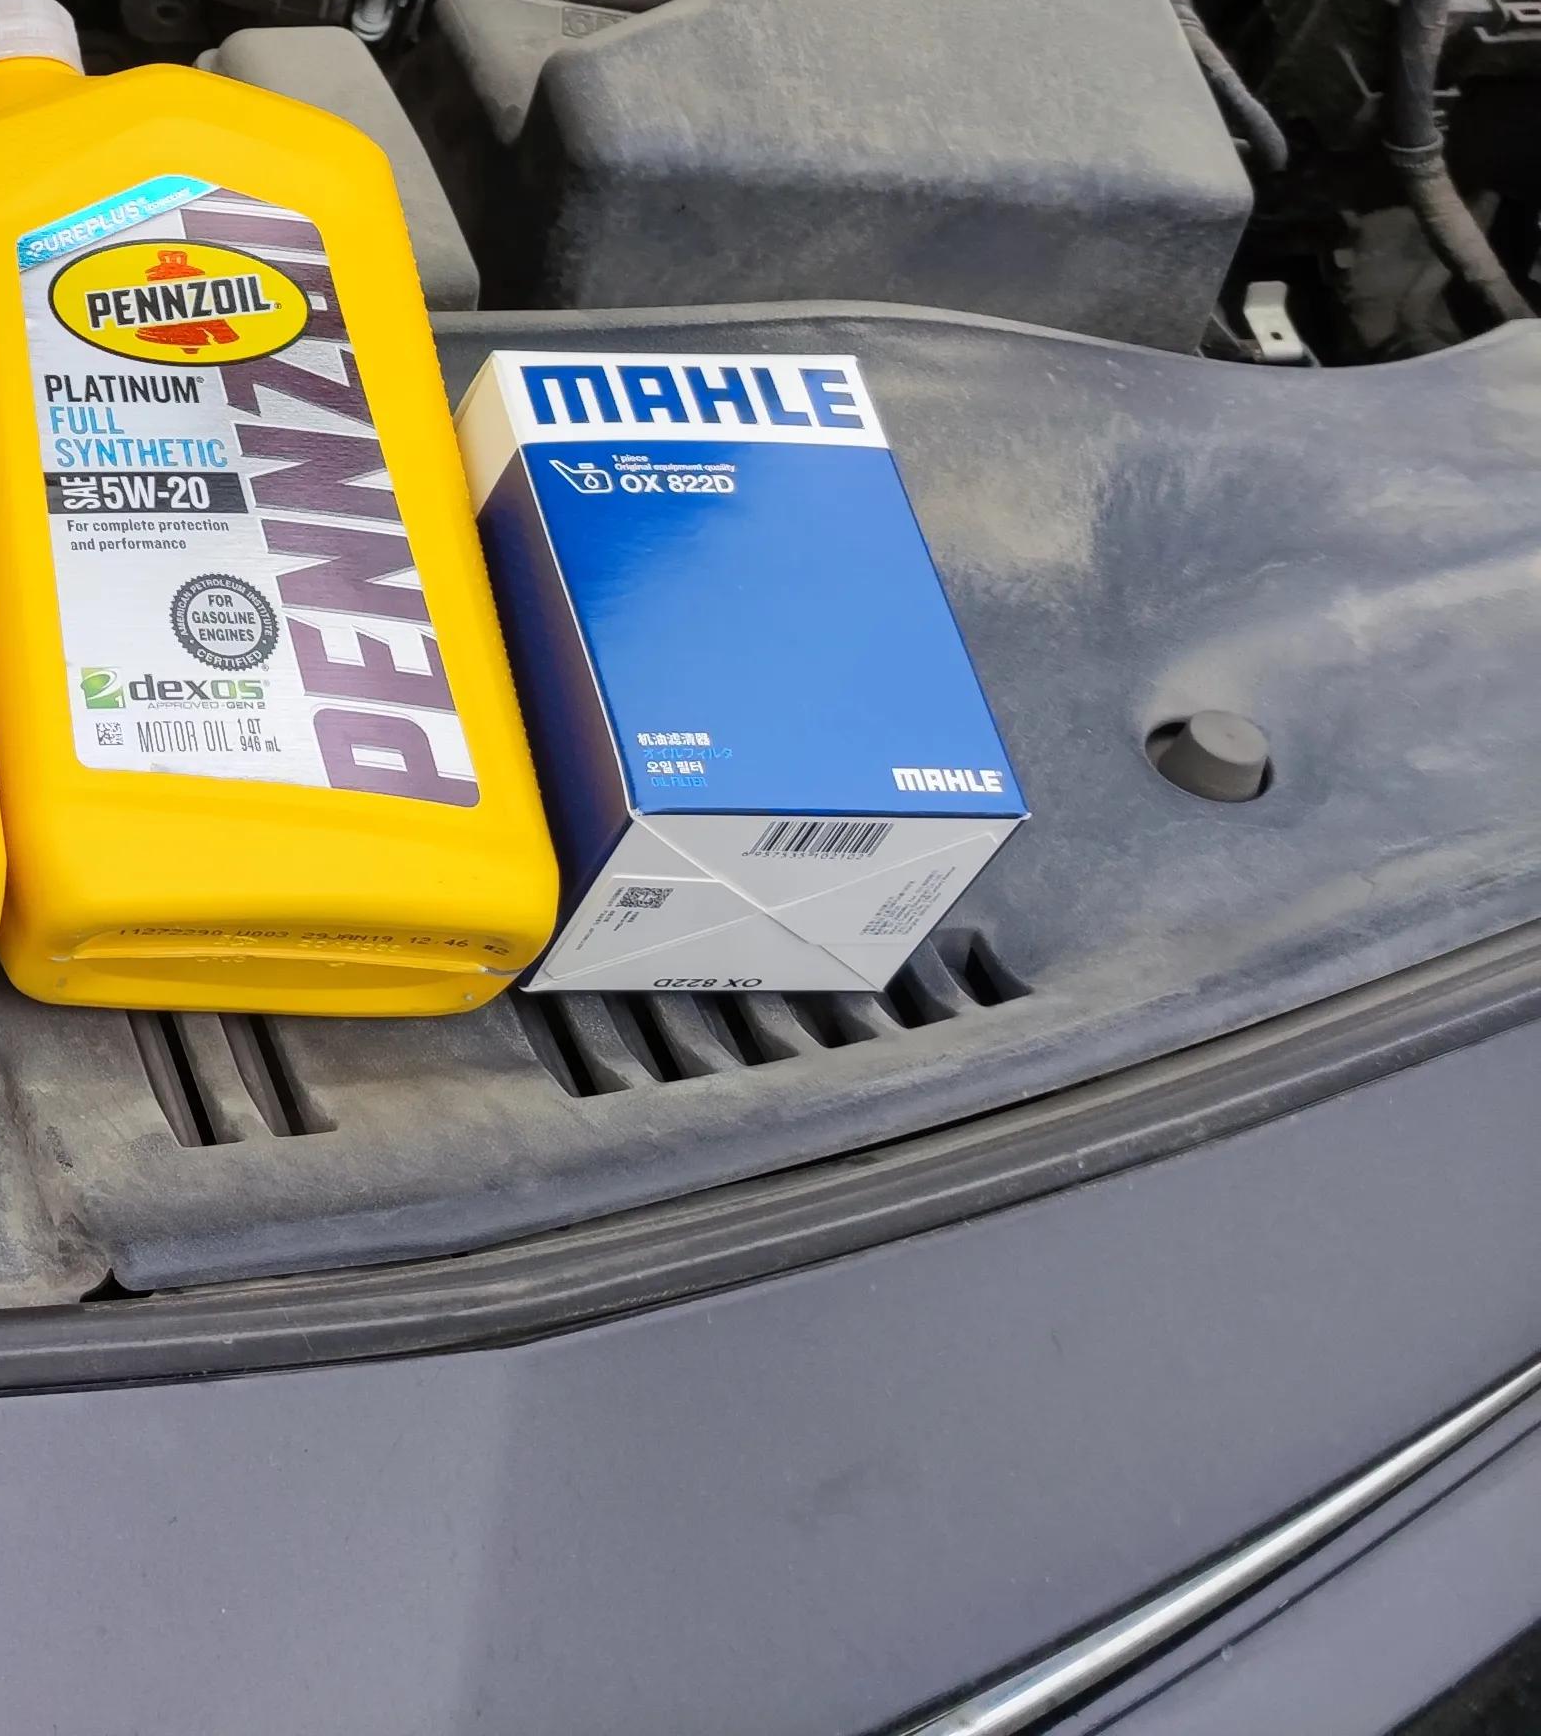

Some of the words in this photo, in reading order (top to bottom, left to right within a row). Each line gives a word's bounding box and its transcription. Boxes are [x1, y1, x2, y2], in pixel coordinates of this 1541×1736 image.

[27, 206, 141, 257] PUREPLUS
[86, 277, 270, 328] PENNZOIL
[45, 375, 200, 404] PLATINUM
[520, 364, 866, 429] MAHLE
[50, 406, 124, 434] FULL
[55, 438, 228, 468] SYNTHETIC
[620, 454, 648, 463] piece
[614, 463, 651, 472] Original
[653, 463, 703, 472] equipment
[705, 464, 736, 473] quality
[62, 476, 100, 509] SAE
[102, 476, 210, 509] 5W-20
[620, 474, 664, 493] OX
[667, 474, 734, 493] 822D
[129, 673, 265, 701] dexos
[137, 721, 197, 753] MOTOR
[205, 720, 233, 753] OIL
[637, 732, 711, 747] 机油滤清器
[647, 761, 673, 774] 오일
[676, 761, 705, 774] 필터
[892, 768, 1004, 792] MAHLE
[653, 977, 718, 989] 822D
[723, 977, 763, 989] OX
